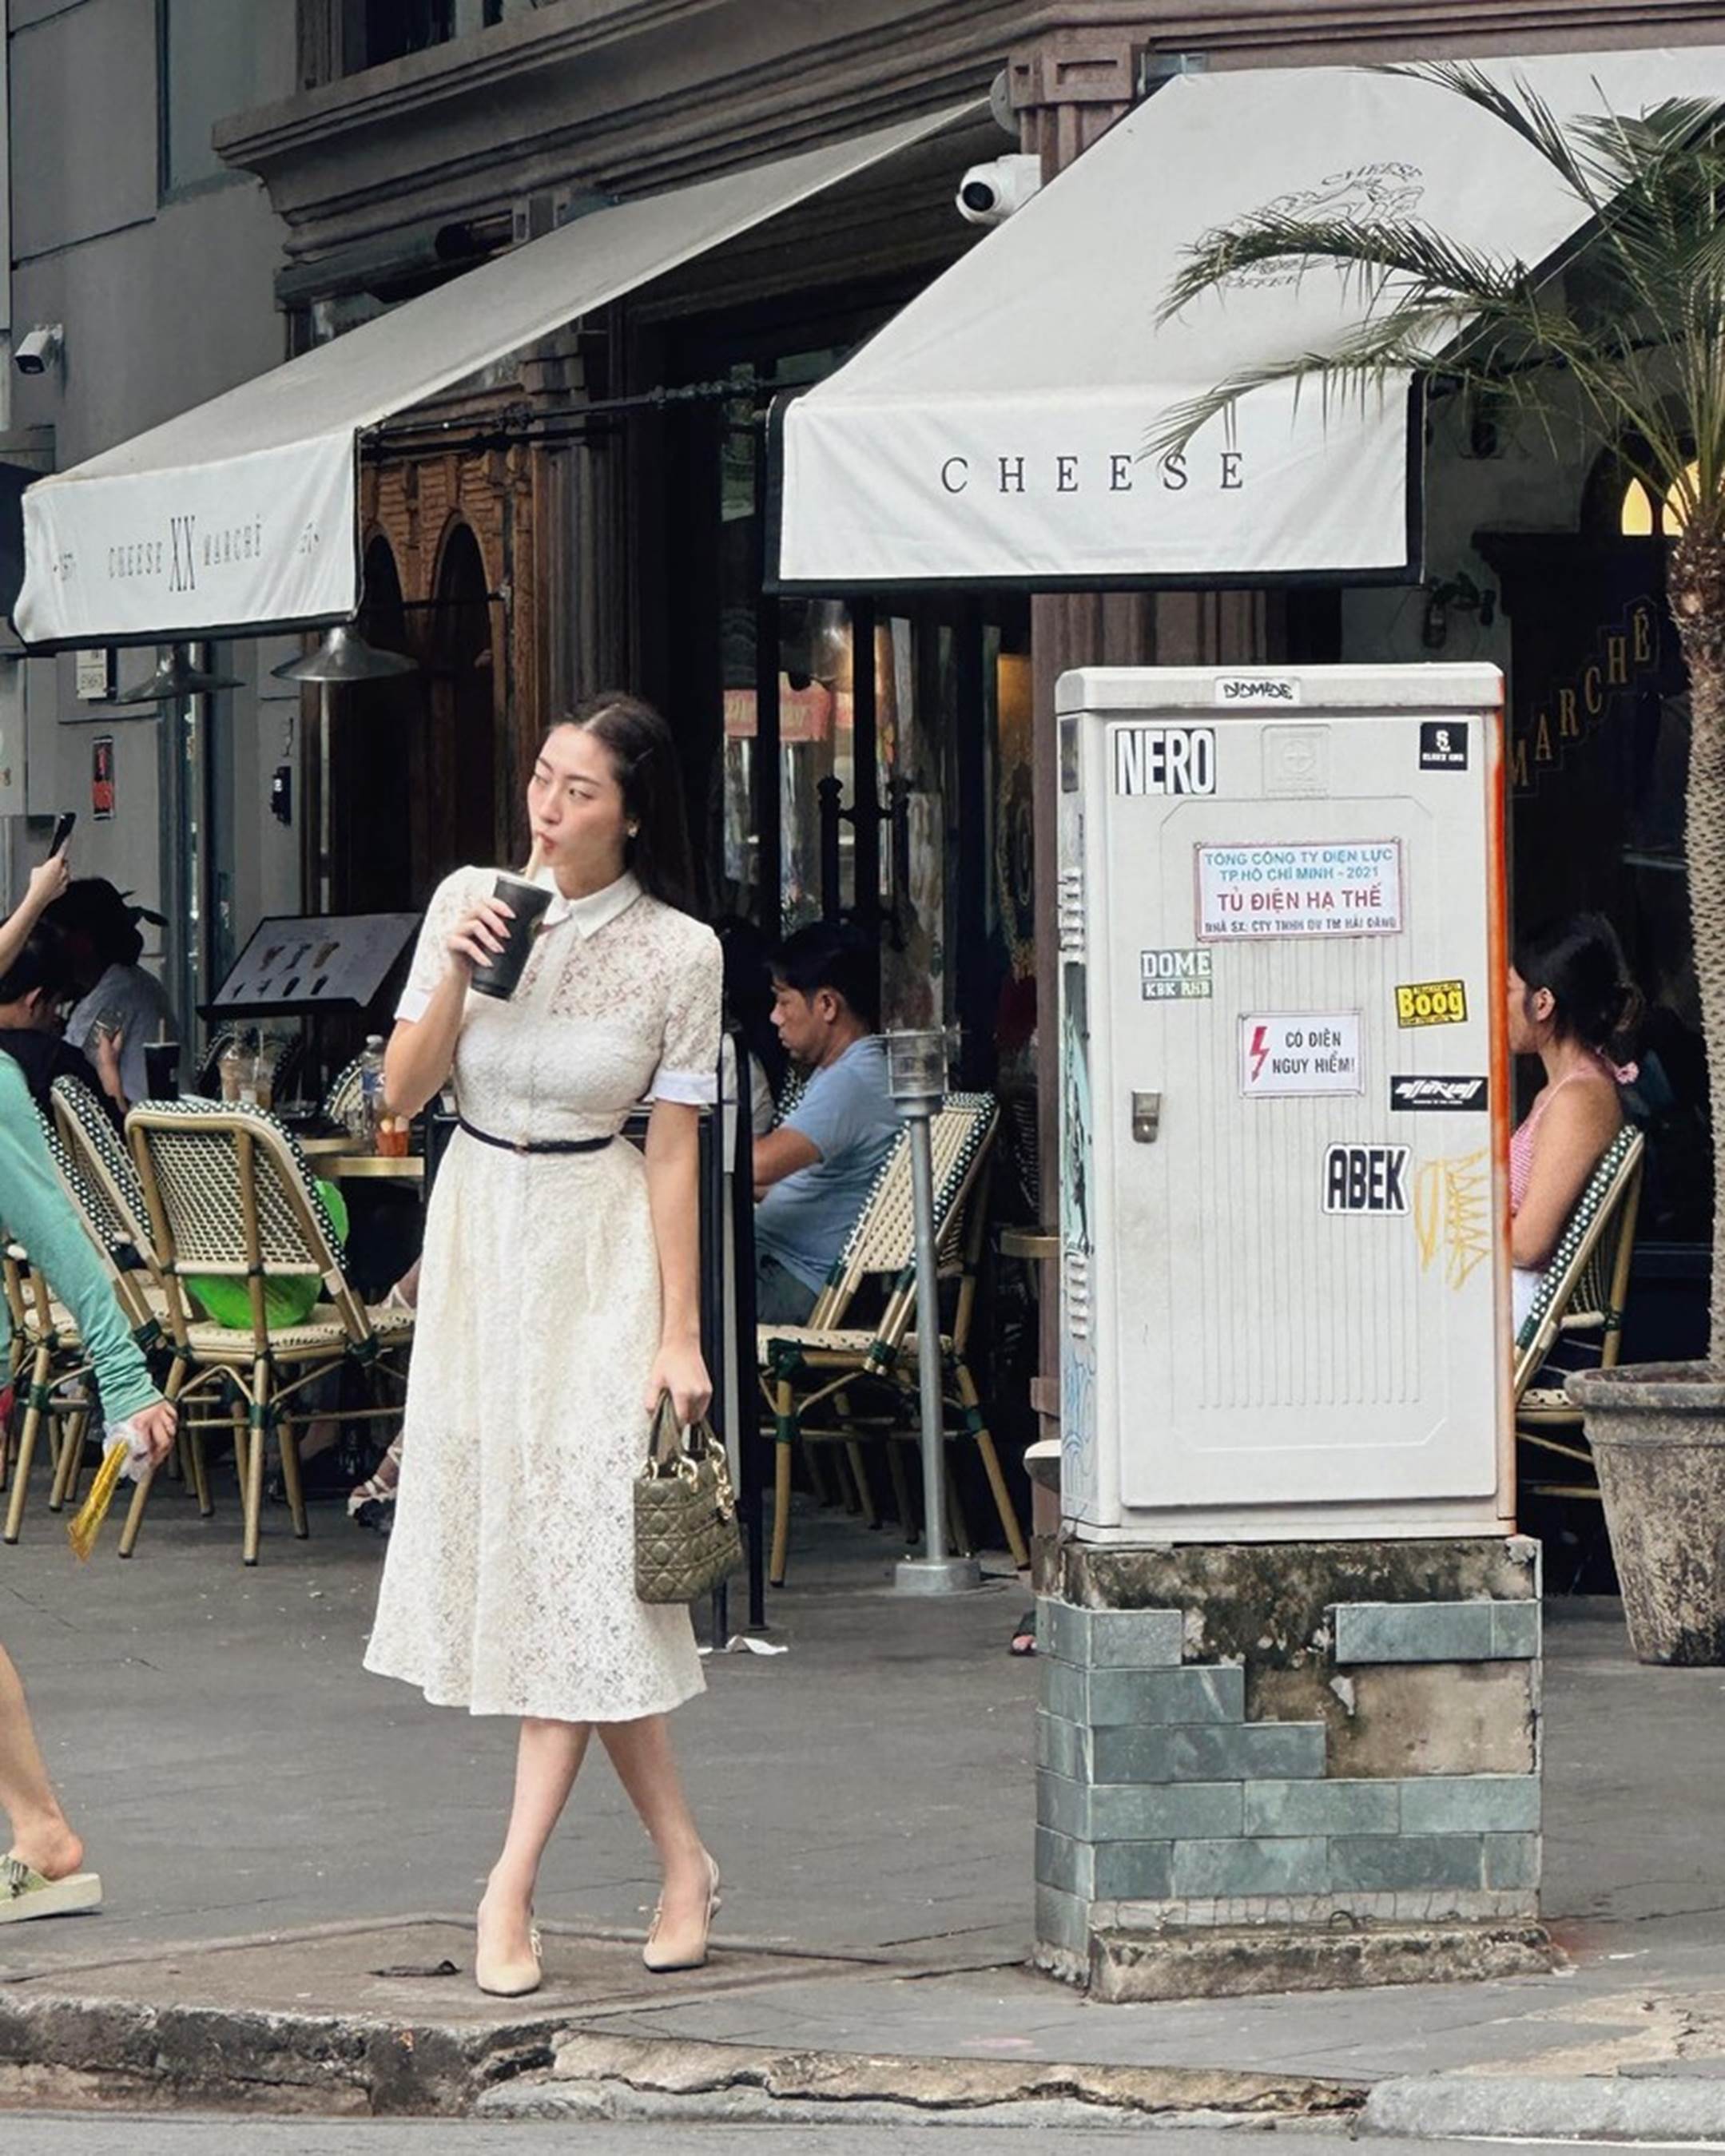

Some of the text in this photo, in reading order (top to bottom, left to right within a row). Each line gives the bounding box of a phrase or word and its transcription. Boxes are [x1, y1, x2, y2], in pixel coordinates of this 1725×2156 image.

[941, 453, 1243, 493] CHEESE
[109, 542, 162, 578] CHEESE
[1117, 729, 1214, 795] NERO
[1296, 868, 1333, 880] MINH
[1346, 866, 1379, 879] 2021
[1301, 852, 1319, 864] TY
[1217, 881, 1382, 914] TỦ ĐIỆN HẠ THẾ
[1143, 951, 1211, 977] DOME
[1397, 987, 1465, 1021] Boog
[1285, 1027, 1303, 1047] CÓ
[1272, 1058, 1310, 1074] NGUY
[1327, 1149, 1407, 1210] ABEK
